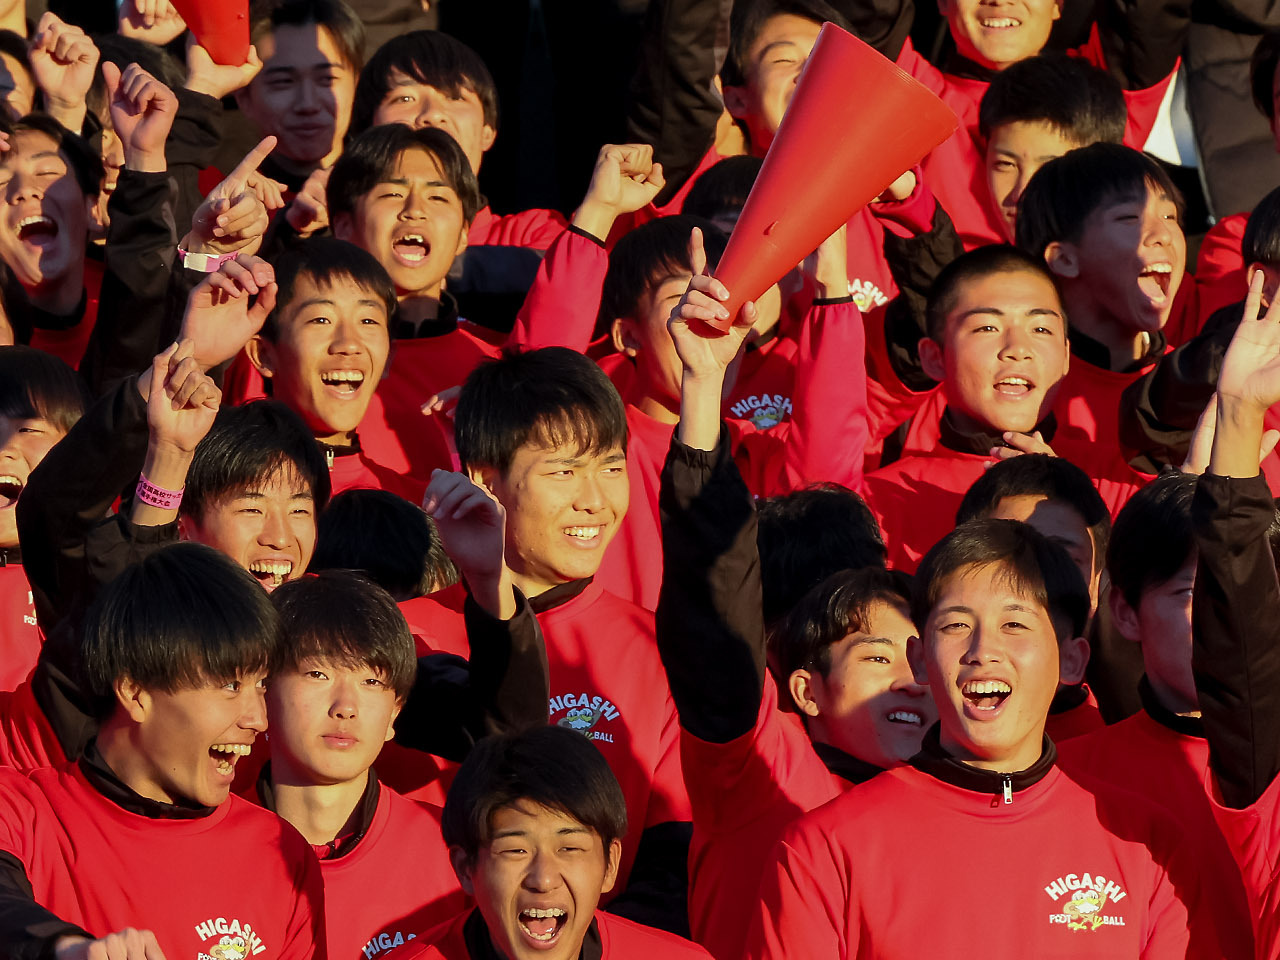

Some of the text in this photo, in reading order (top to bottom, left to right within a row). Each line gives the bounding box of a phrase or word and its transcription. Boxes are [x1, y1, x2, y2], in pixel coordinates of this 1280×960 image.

[730, 393, 793, 417] HIGASH
[549, 692, 620, 722] HIGASHI
[594, 731, 614, 743] BALL
[1044, 872, 1127, 904] HIGASHI
[1049, 914, 1125, 926] FOOT BALL
[194, 917, 266, 956] HIGASHI
